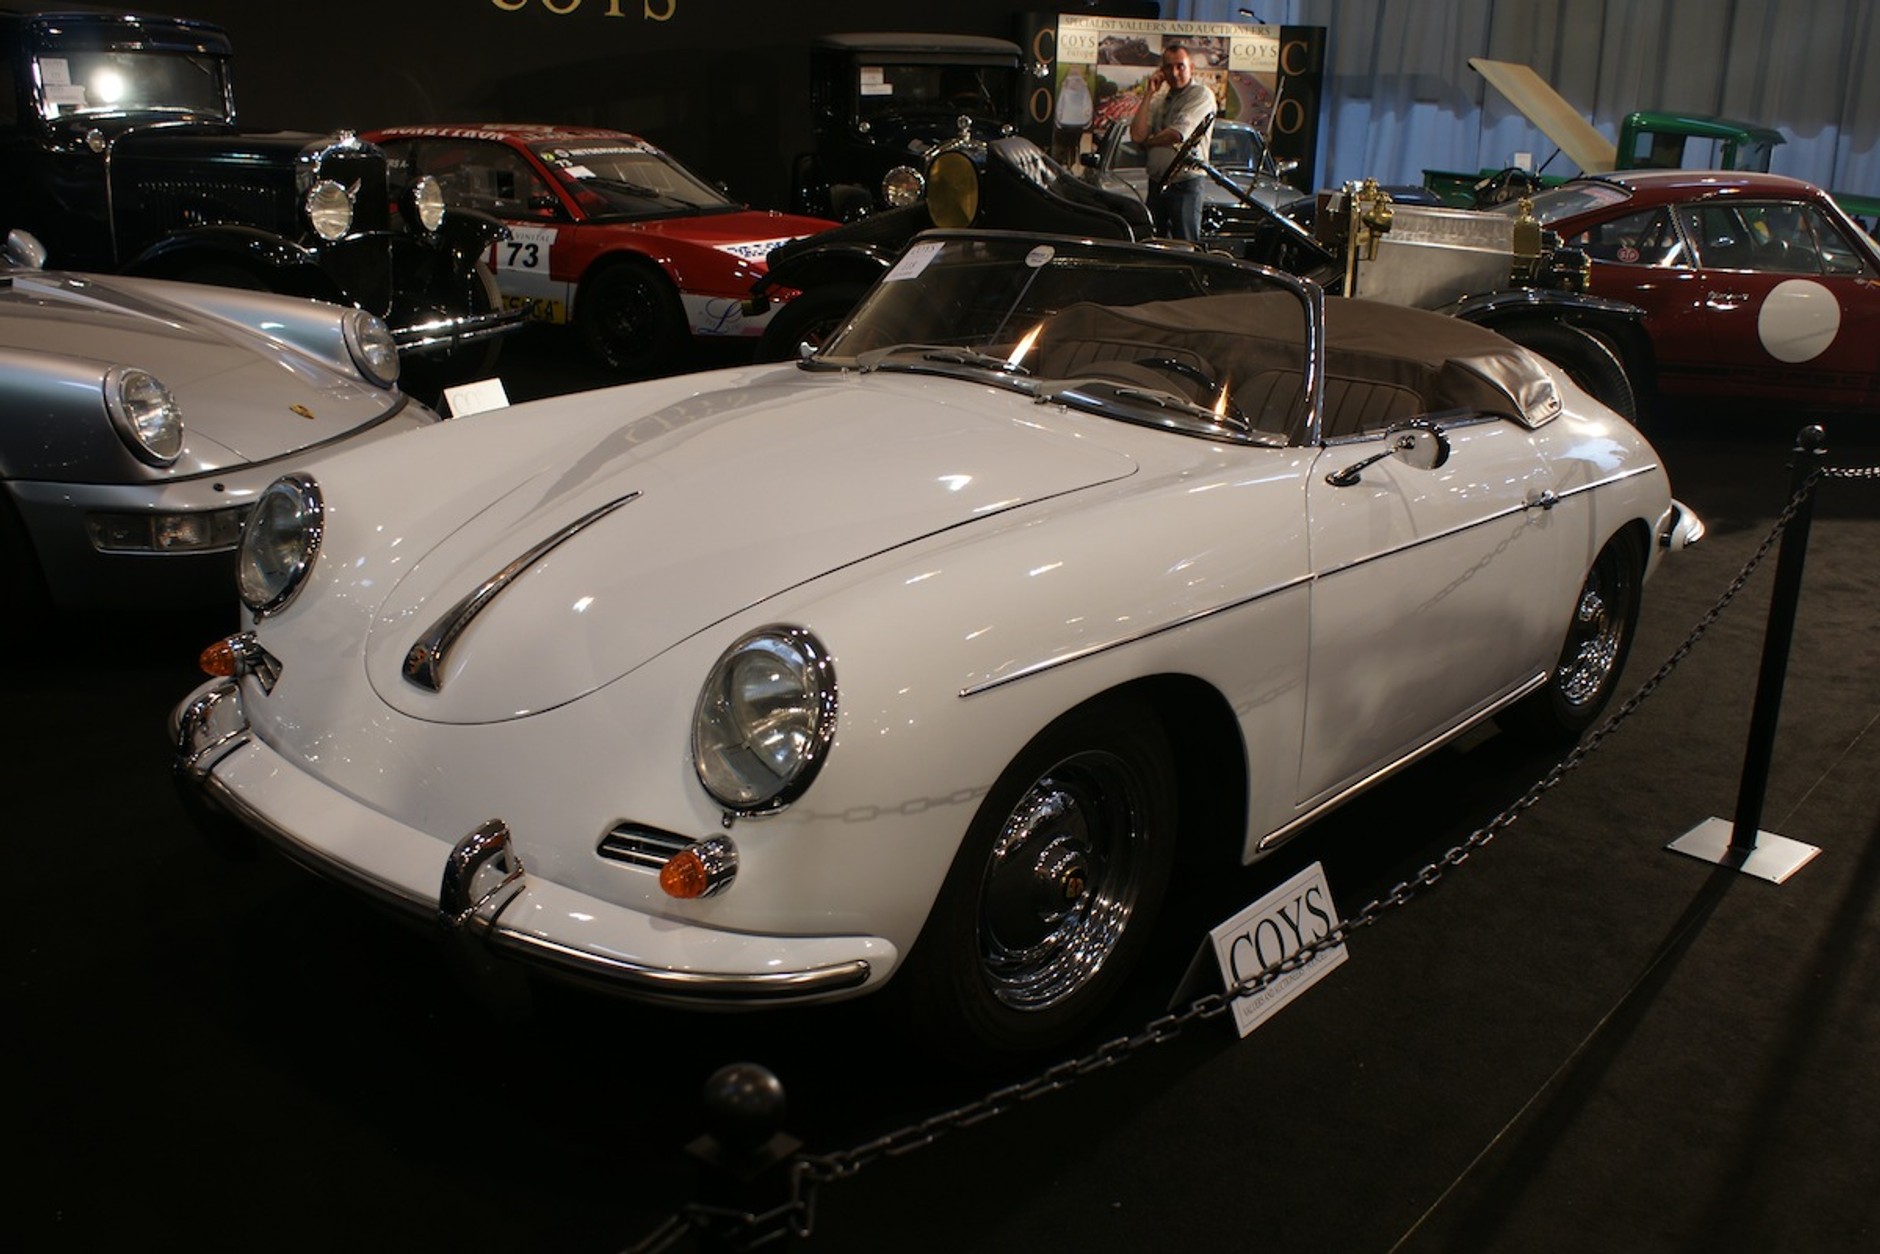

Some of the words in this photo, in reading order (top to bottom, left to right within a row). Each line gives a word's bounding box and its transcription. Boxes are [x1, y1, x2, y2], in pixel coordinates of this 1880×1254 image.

[1064, 17, 1117, 30] SPECIALIST
[1119, 20, 1167, 31] VALUERS
[1169, 22, 1194, 33] AND
[1195, 23, 1271, 36] AUCTIONEERS
[1060, 34, 1095, 48] COYS
[1233, 44, 1277, 58] COYS
[507, 242, 539, 268] 73
[1230, 886, 1330, 988] COYS
